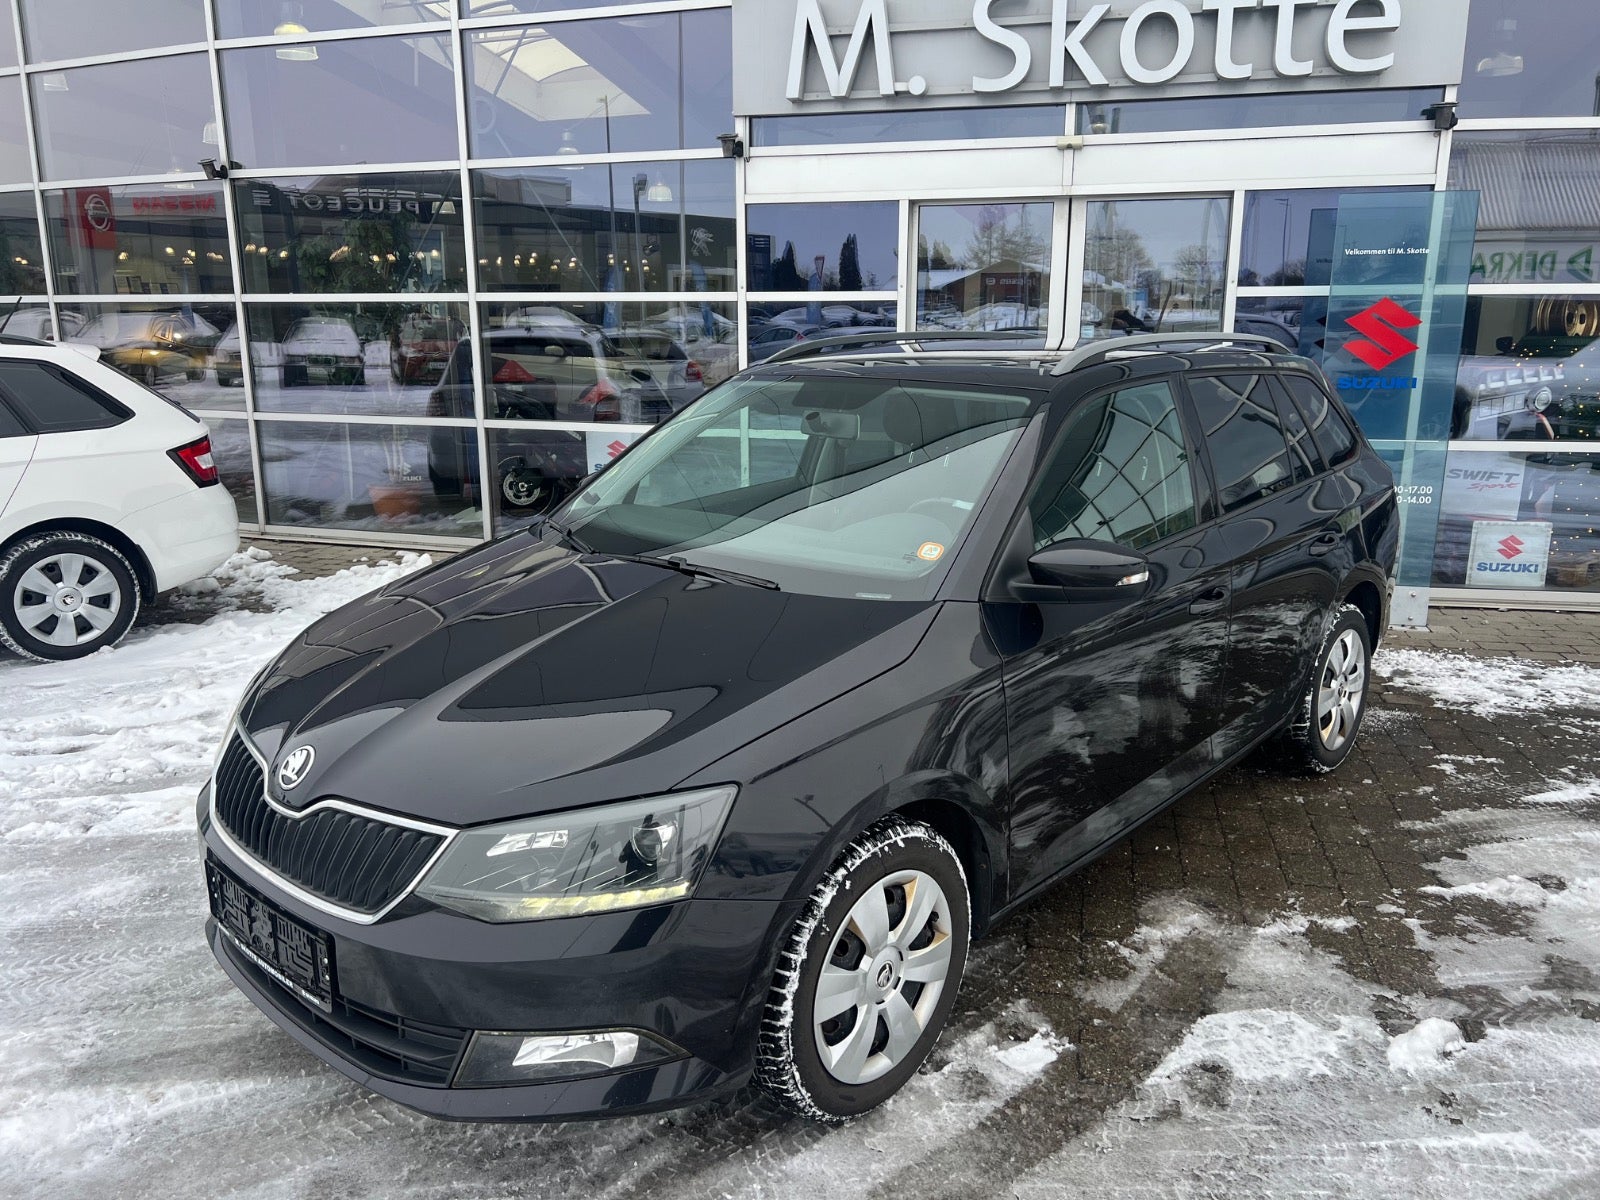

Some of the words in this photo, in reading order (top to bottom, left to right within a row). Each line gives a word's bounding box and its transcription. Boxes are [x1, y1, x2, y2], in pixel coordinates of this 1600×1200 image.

[786, 0, 927, 102] M.
[972, 0, 1402, 95] Skotte
[1337, 376, 1417, 389] SUZUKI
[1446, 468, 1520, 482] SWIFT
[1466, 482, 1520, 492] Sport
[1476, 562, 1539, 573] SUZUKI
